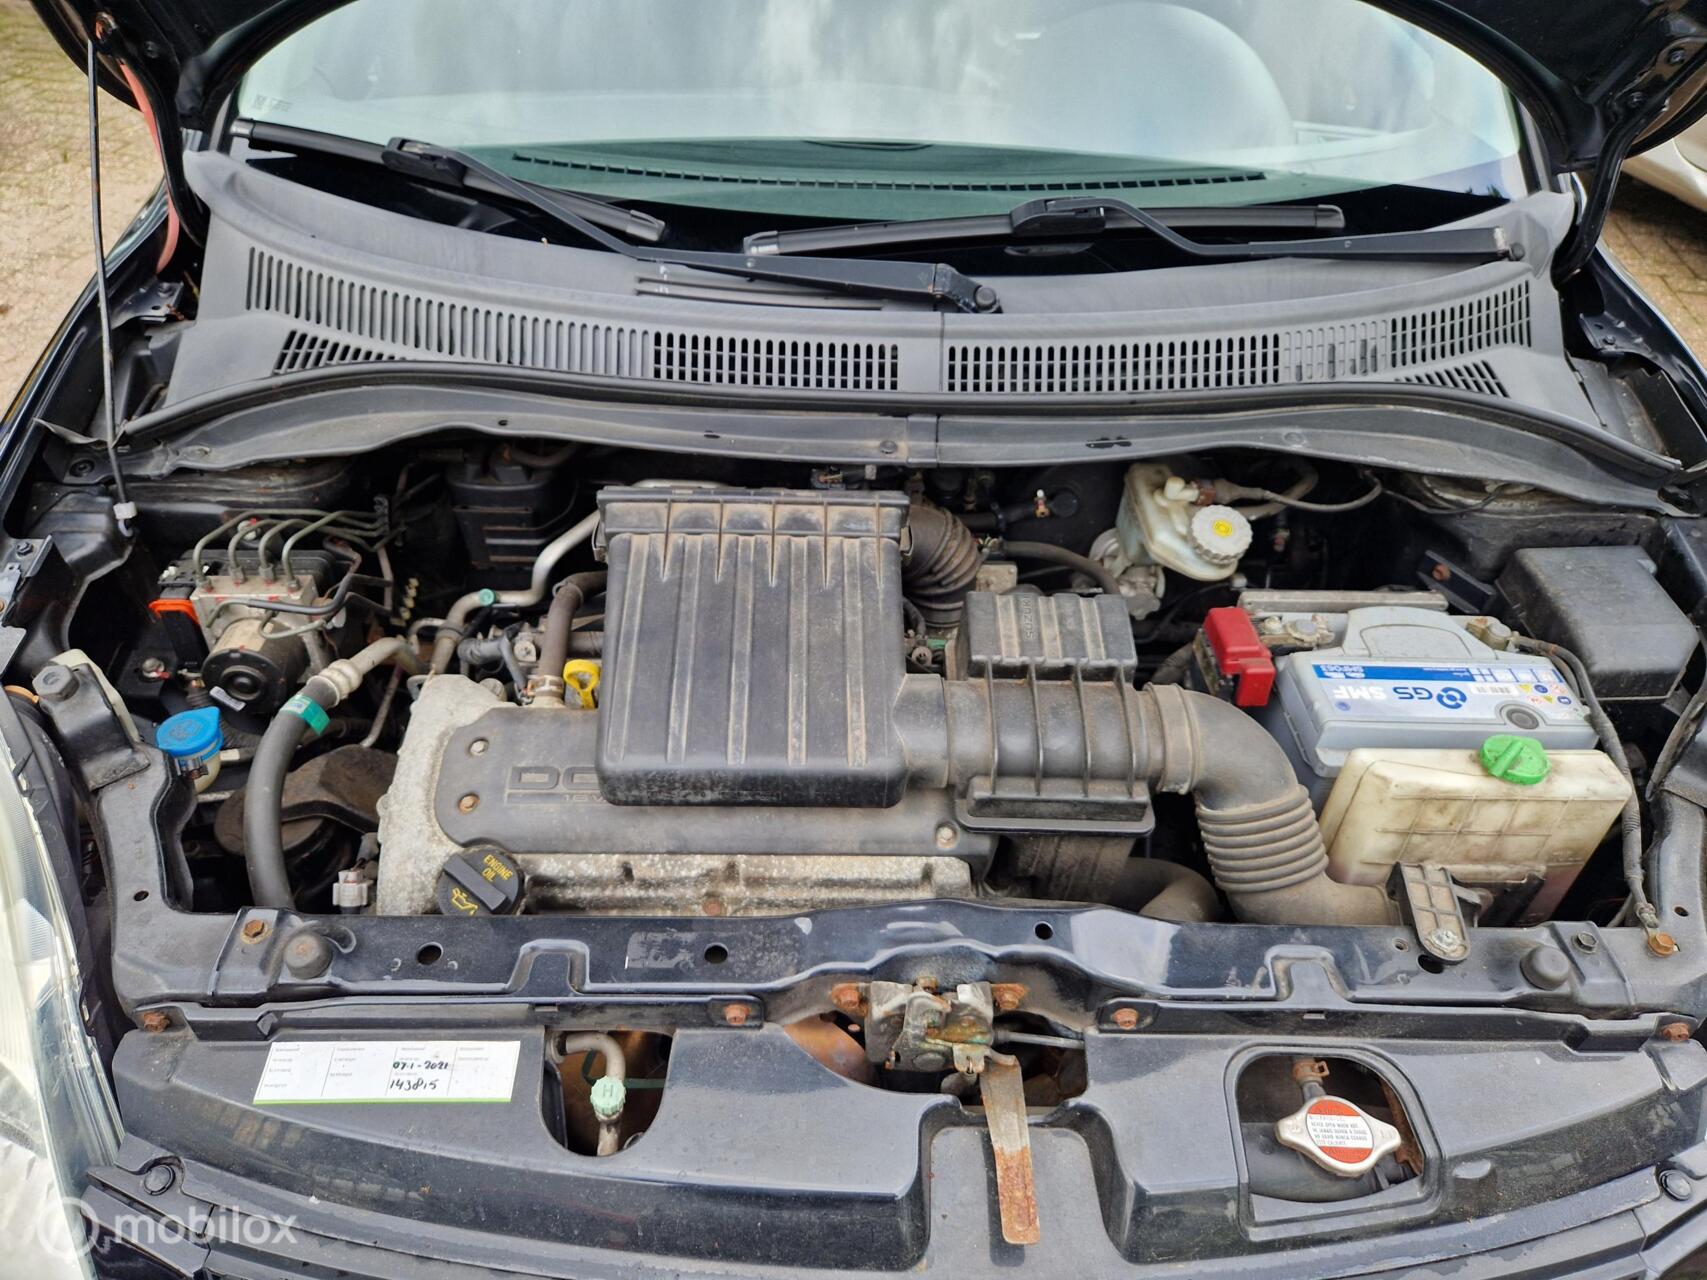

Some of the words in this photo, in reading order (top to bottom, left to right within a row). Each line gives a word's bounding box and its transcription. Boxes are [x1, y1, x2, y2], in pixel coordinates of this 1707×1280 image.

[1021, 597, 1033, 639] SUZUKI
[1333, 685, 1386, 700] SMF
[1393, 686, 1433, 700] GS
[482, 867, 497, 882] OIL
[483, 854, 513, 880] ENGINE
[390, 1077, 439, 1091] 143815
[603, 1084, 613, 1097] H
